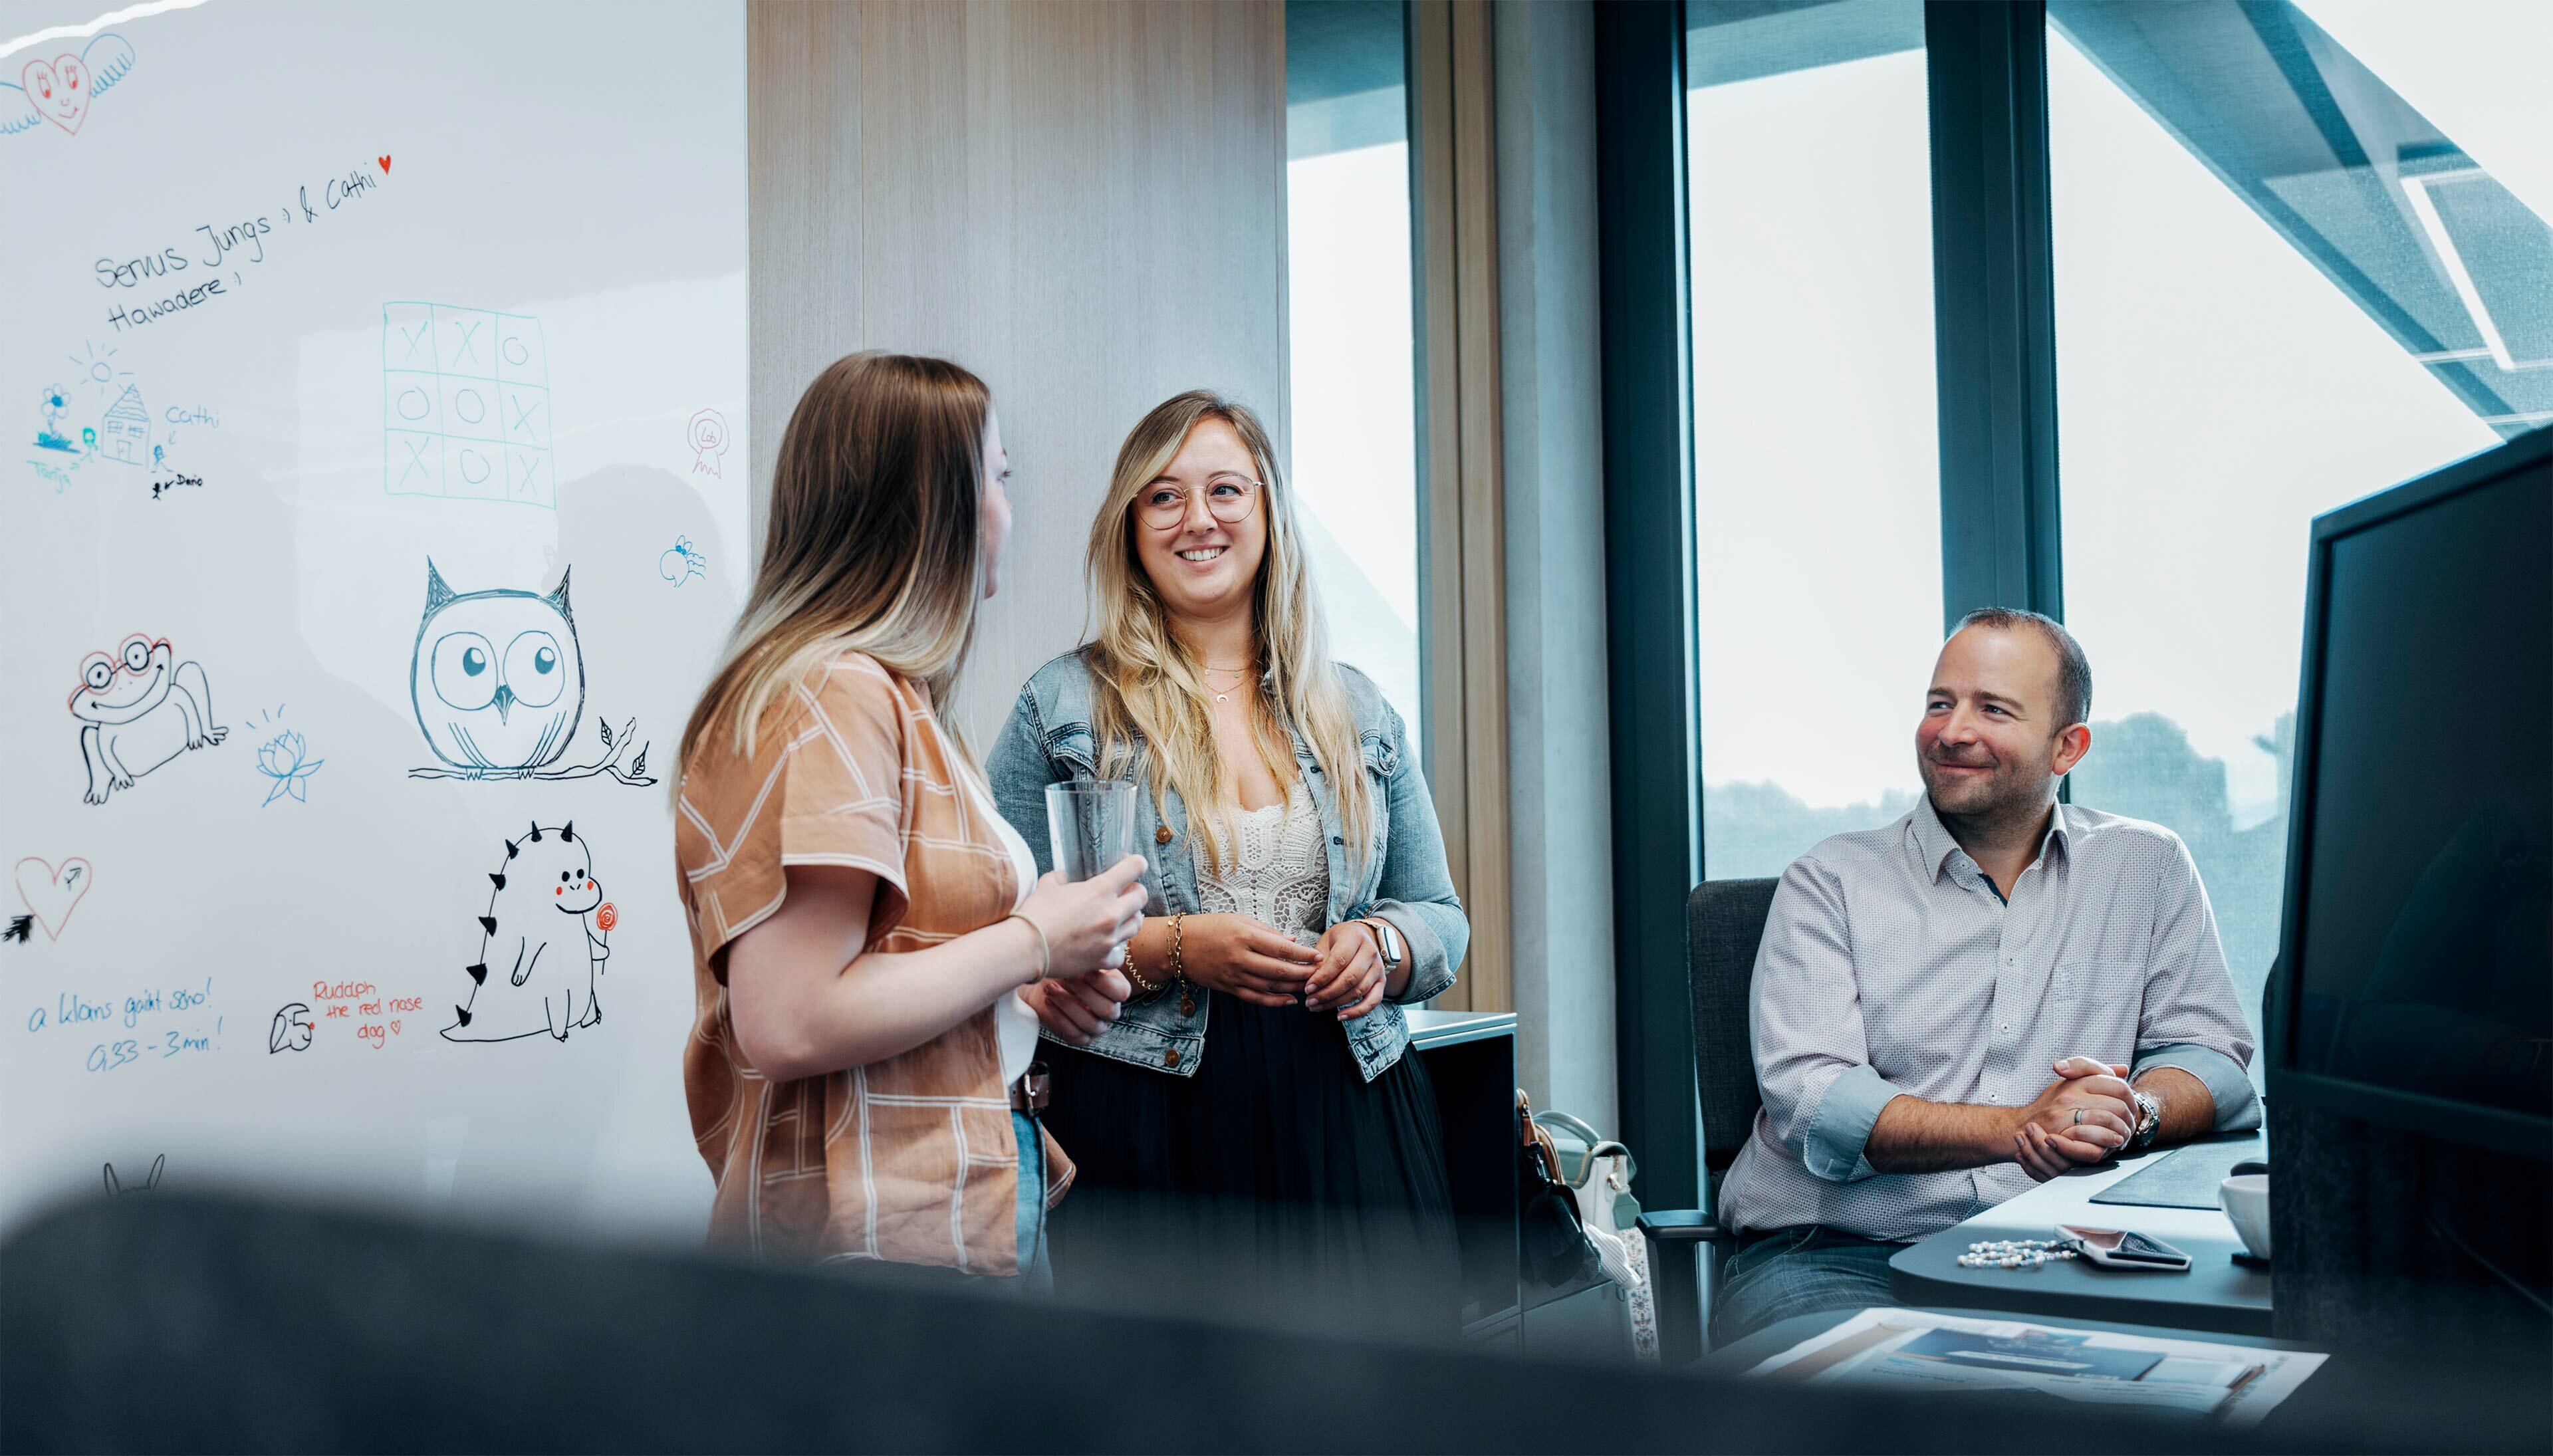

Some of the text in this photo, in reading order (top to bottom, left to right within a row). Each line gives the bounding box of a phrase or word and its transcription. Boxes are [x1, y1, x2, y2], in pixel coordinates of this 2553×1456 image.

[95, 248, 188, 288] Servus
[195, 217, 271, 267] Jungs
[326, 162, 376, 210] Cathi
[108, 279, 227, 331] Hawadere
[165, 405, 219, 428] Cathi
[326, 997, 423, 1019] the red nose
[357, 1024, 385, 1050] dog
